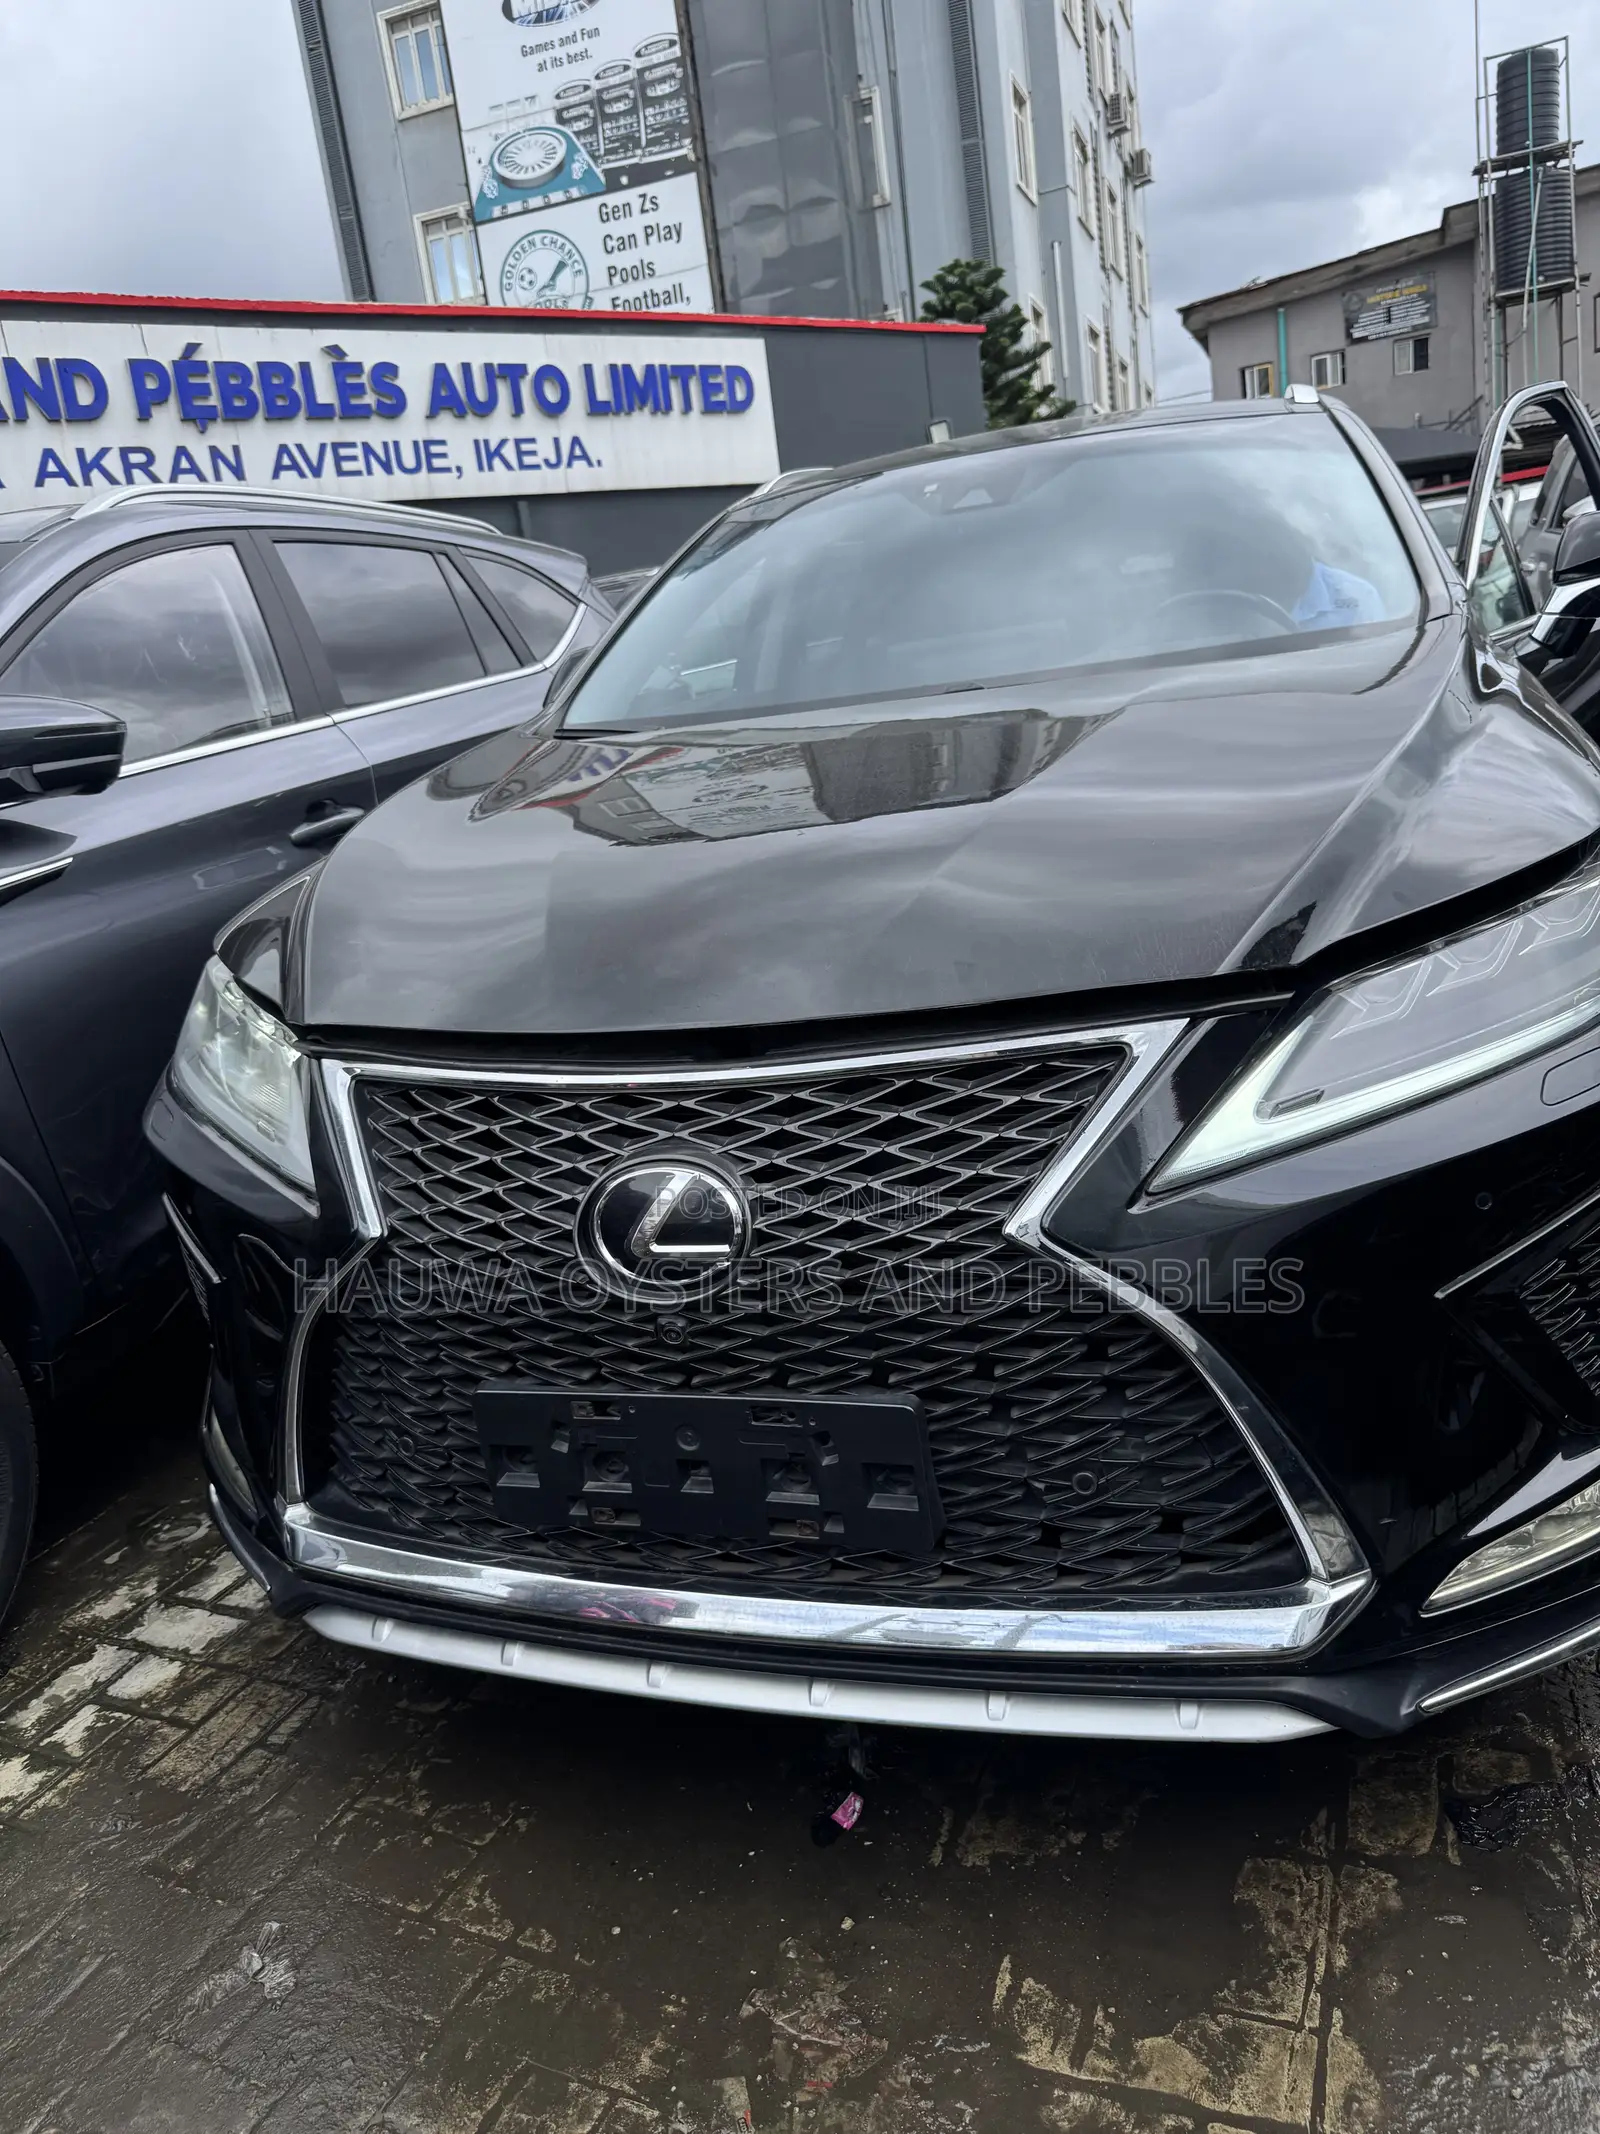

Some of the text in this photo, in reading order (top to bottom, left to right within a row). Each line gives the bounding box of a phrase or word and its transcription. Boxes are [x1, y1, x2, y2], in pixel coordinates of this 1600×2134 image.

[521, 27, 600, 58] Games and Fun
[537, 48, 593, 73] at its best.
[599, 193, 660, 223] Gen Zs
[603, 222, 682, 255] Can Play
[505, 235, 584, 292] GOLDEN CHANCE
[607, 258, 656, 286] Pools
[611, 282, 691, 311] Football,
[0, 357, 109, 422] ND
[426, 362, 571, 419] AUTO
[582, 363, 754, 417] LIMITED
[35, 435, 604, 488] AKRAN AVENUE, IKEJA.
